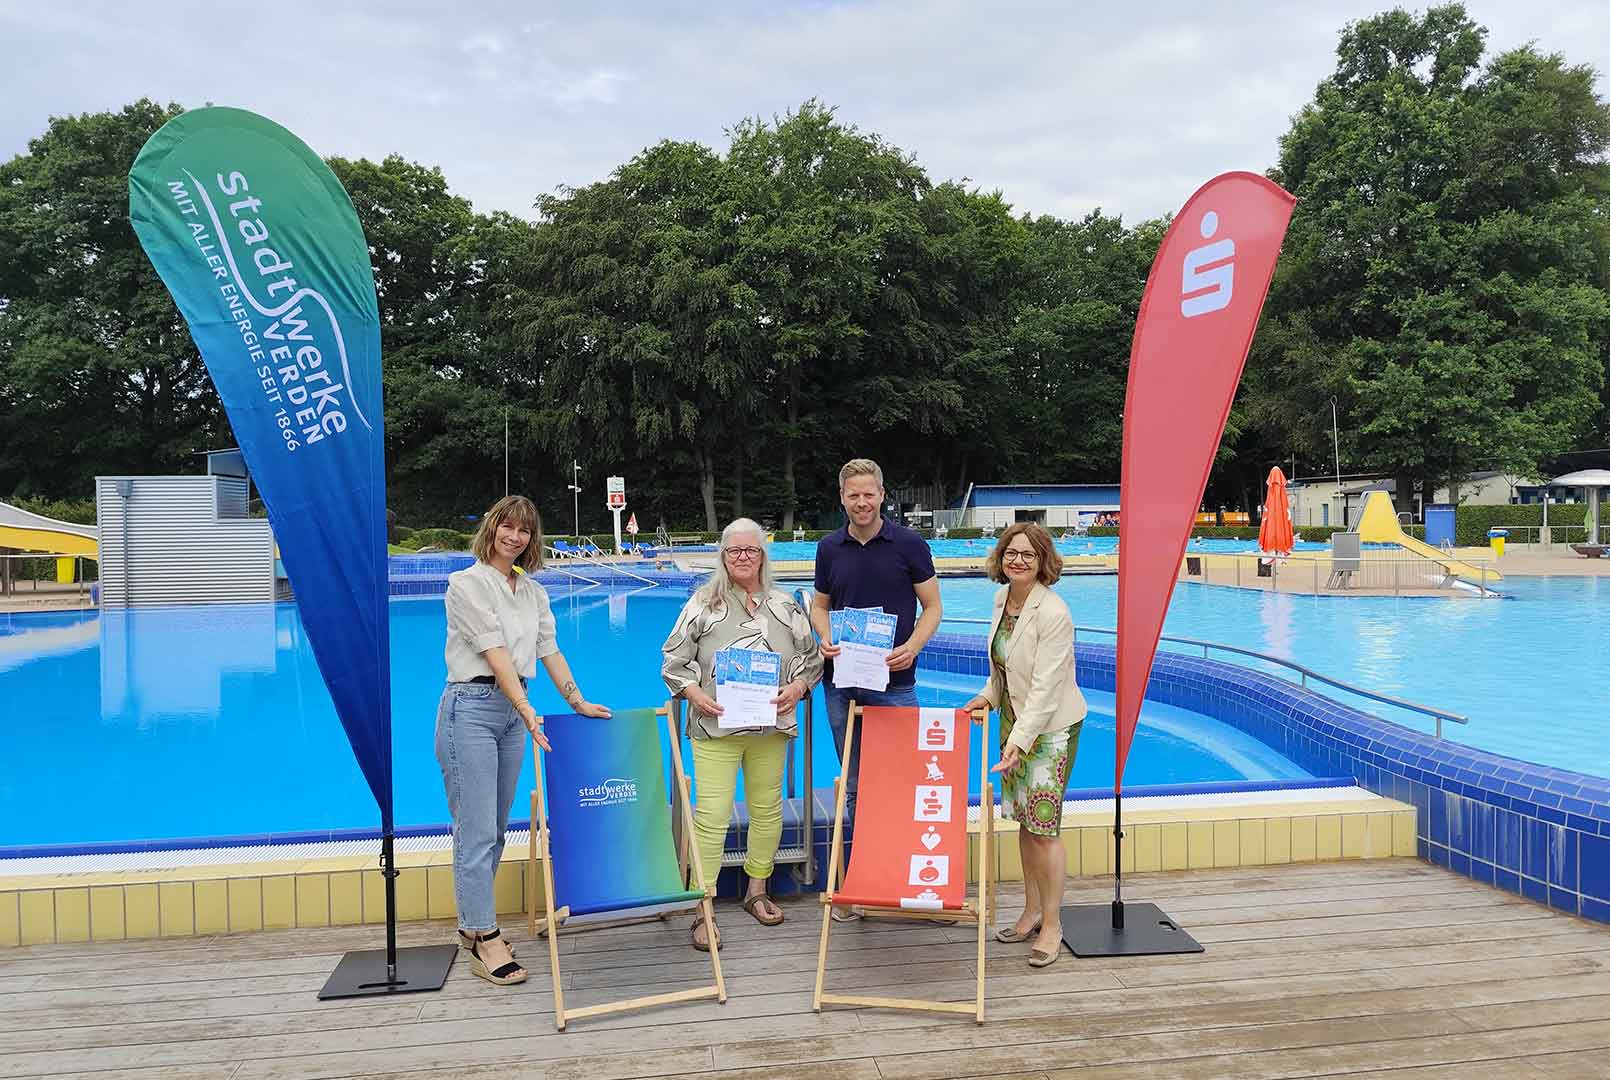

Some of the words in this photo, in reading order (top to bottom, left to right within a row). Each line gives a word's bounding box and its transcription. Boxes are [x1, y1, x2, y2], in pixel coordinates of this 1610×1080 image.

[167, 180, 199, 218] MIT
[188, 221, 229, 280] ALLER
[219, 284, 265, 362] ENERGIE
[257, 366, 284, 404] SEIT
[274, 407, 301, 452] 1866
[263, 321, 326, 447] VERDEN
